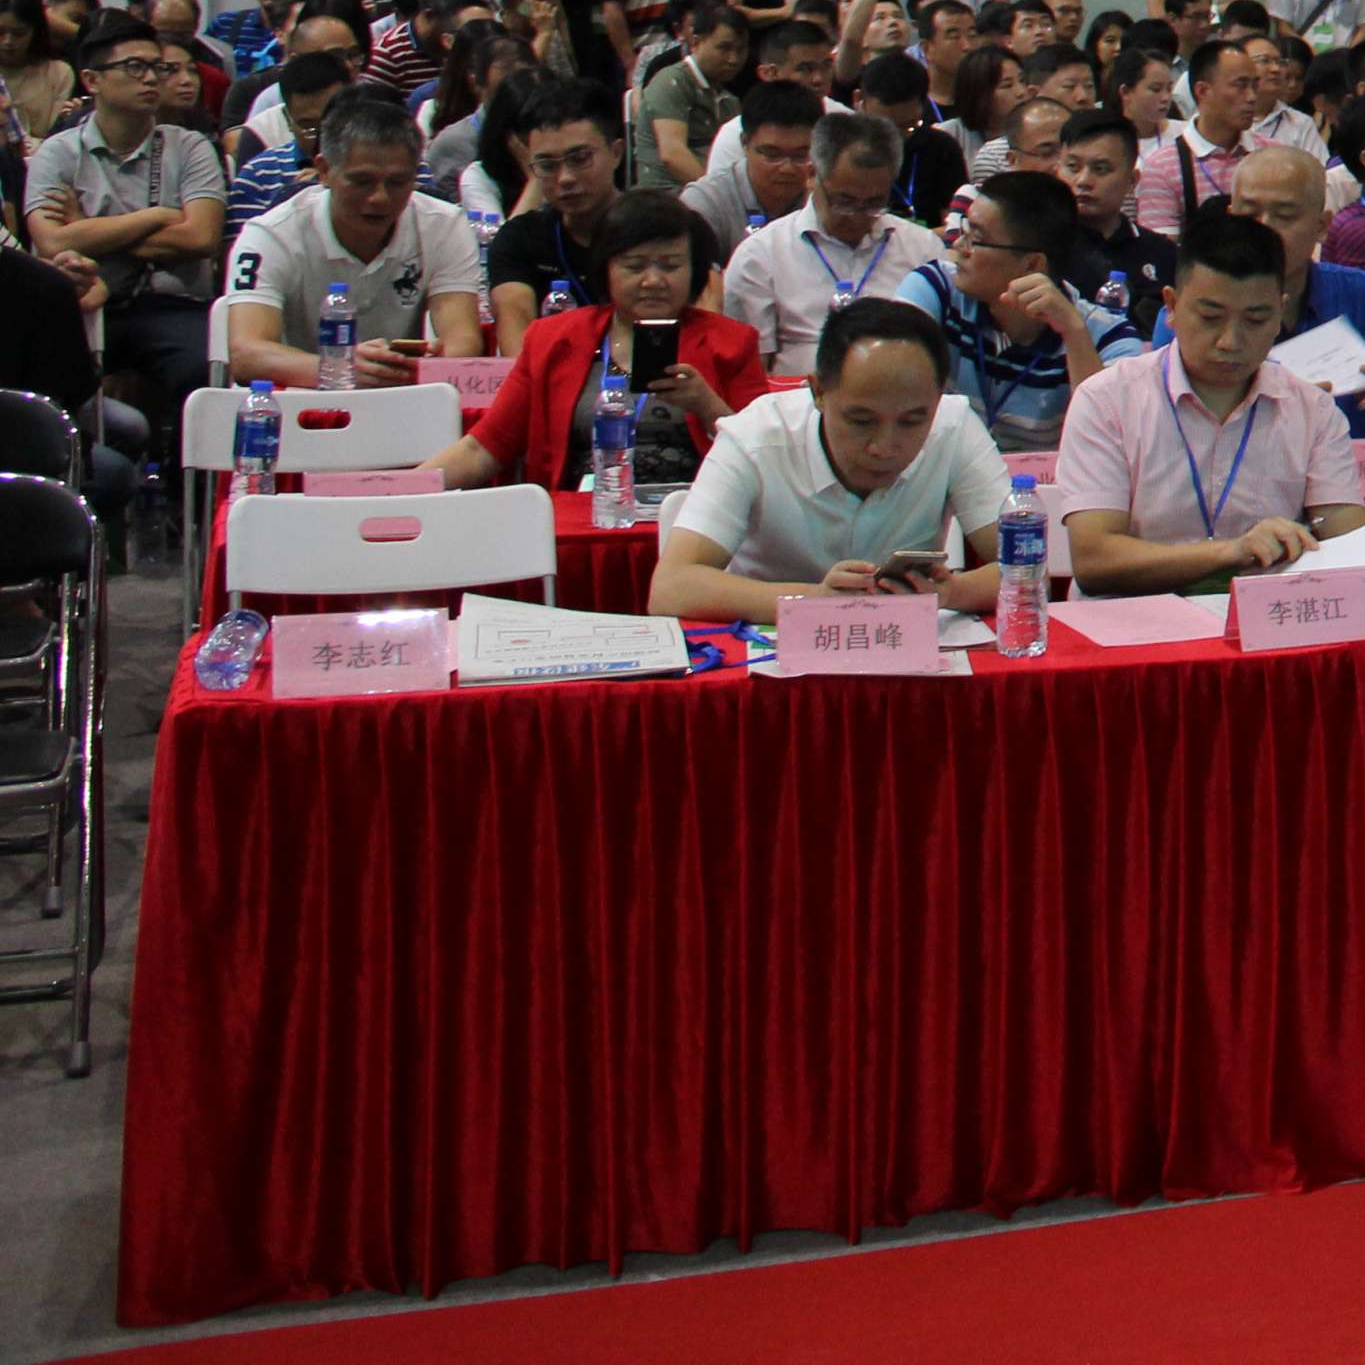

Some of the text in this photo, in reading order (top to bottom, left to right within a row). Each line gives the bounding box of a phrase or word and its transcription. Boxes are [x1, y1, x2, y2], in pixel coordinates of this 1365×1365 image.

[234, 252, 262, 291] 3
[1268, 596, 1349, 626] 李湛江
[813, 622, 904, 652] 胡昌峰
[311, 640, 411, 671] 李志红
